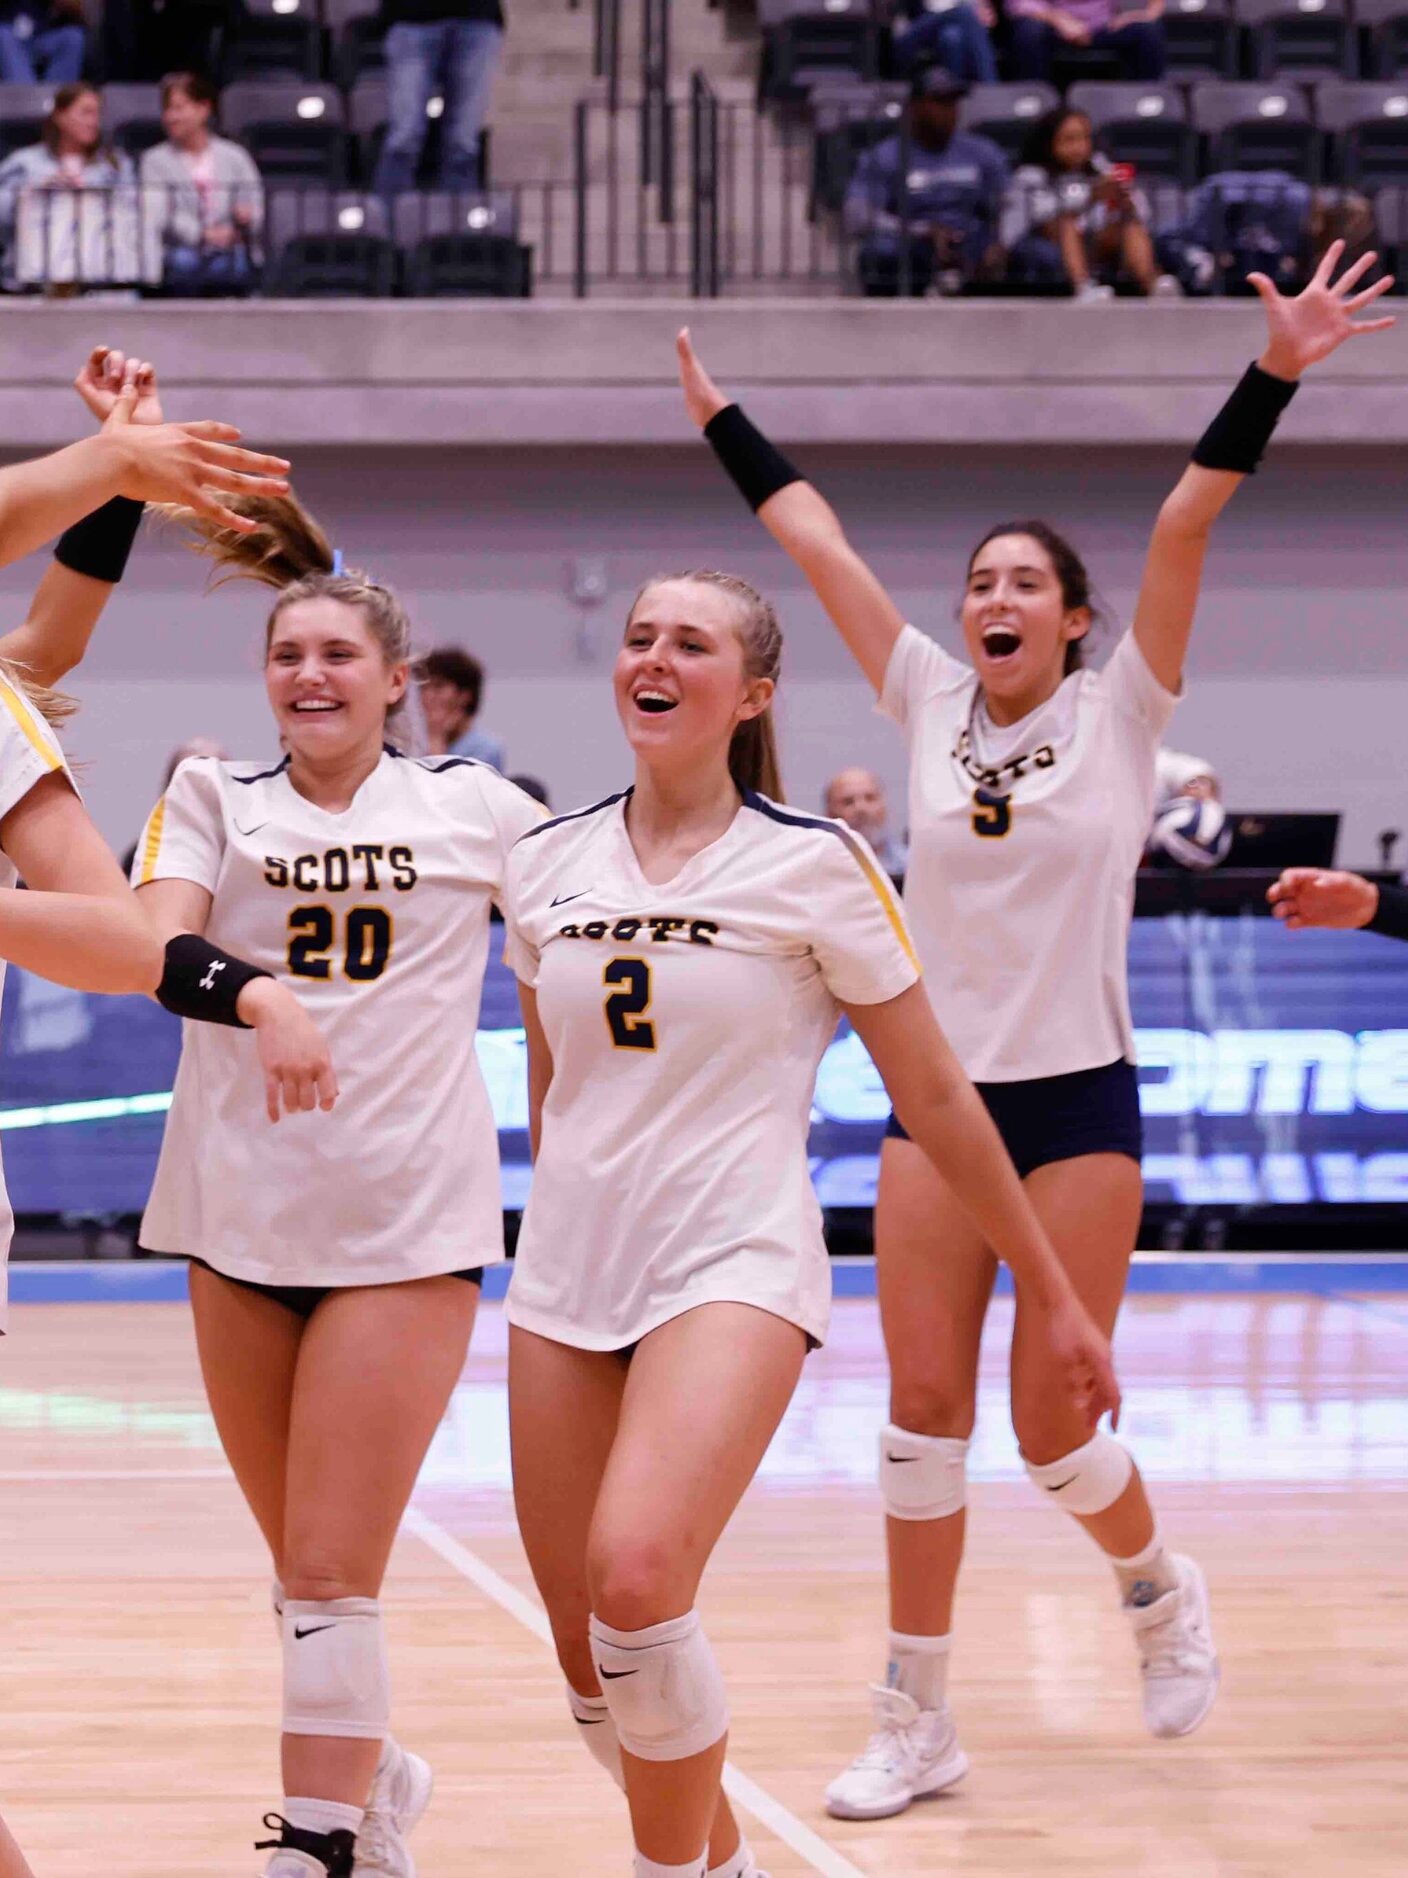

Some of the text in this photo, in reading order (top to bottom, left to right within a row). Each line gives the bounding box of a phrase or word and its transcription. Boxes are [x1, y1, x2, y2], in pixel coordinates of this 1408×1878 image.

[264, 844, 418, 892] SCOTS
[287, 904, 394, 983] 20
[602, 955, 658, 1054] 2
